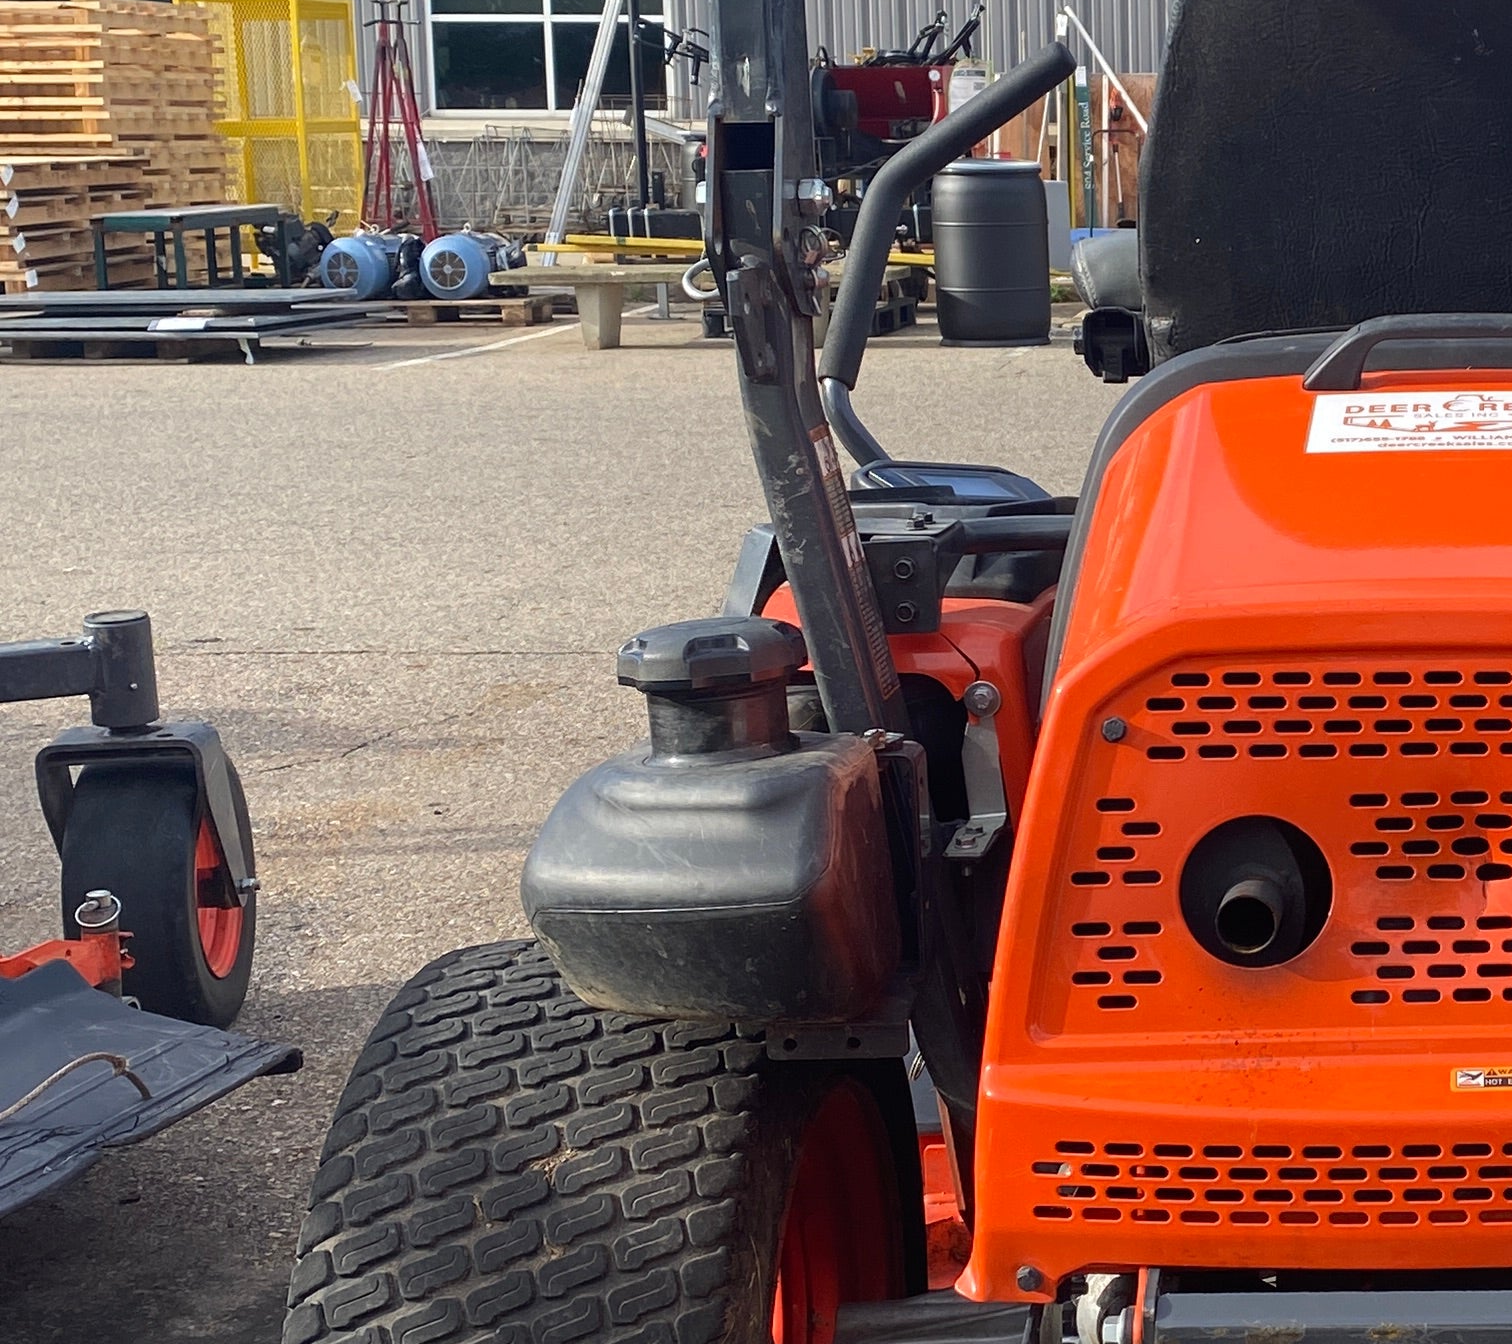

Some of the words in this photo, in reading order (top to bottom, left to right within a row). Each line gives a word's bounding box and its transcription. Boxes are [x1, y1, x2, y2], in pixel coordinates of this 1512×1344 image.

[1078, 102, 1090, 129] Road
[1083, 132, 1092, 168] Service
[1345, 404, 1431, 414] DEER
[1485, 1078, 1503, 1086] HOT
